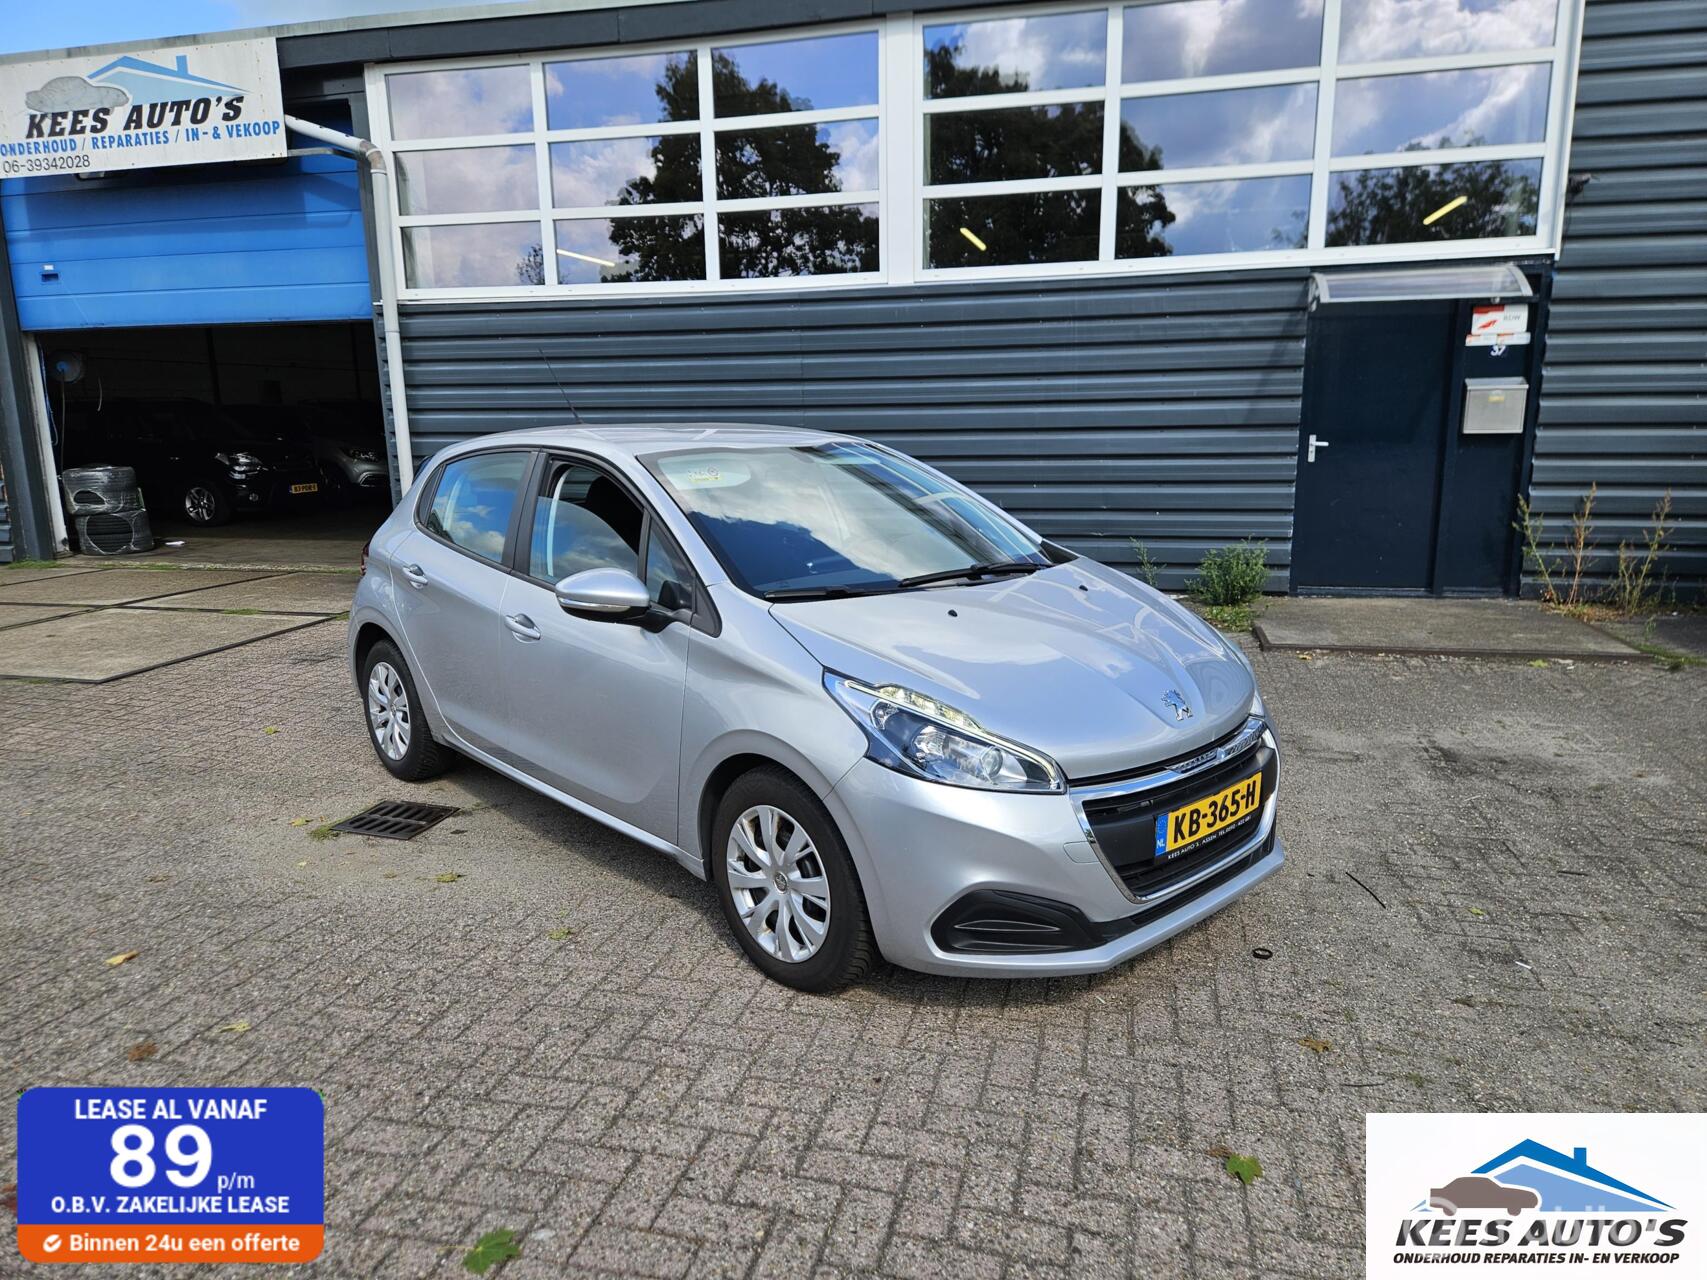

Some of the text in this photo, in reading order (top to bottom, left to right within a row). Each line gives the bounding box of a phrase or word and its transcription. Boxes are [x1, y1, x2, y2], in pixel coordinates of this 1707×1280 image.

[26, 96, 244, 138] KEES AUTO'S
[0, 138, 77, 156] ONDERHOUD
[91, 130, 169, 149] REPARATIES
[212, 126, 221, 139] &
[226, 121, 280, 138] VEKOOP
[3, 154, 91, 173] 06-39342028
[1173, 780, 1256, 844] KB-365-H
[1156, 838, 1166, 849] NL
